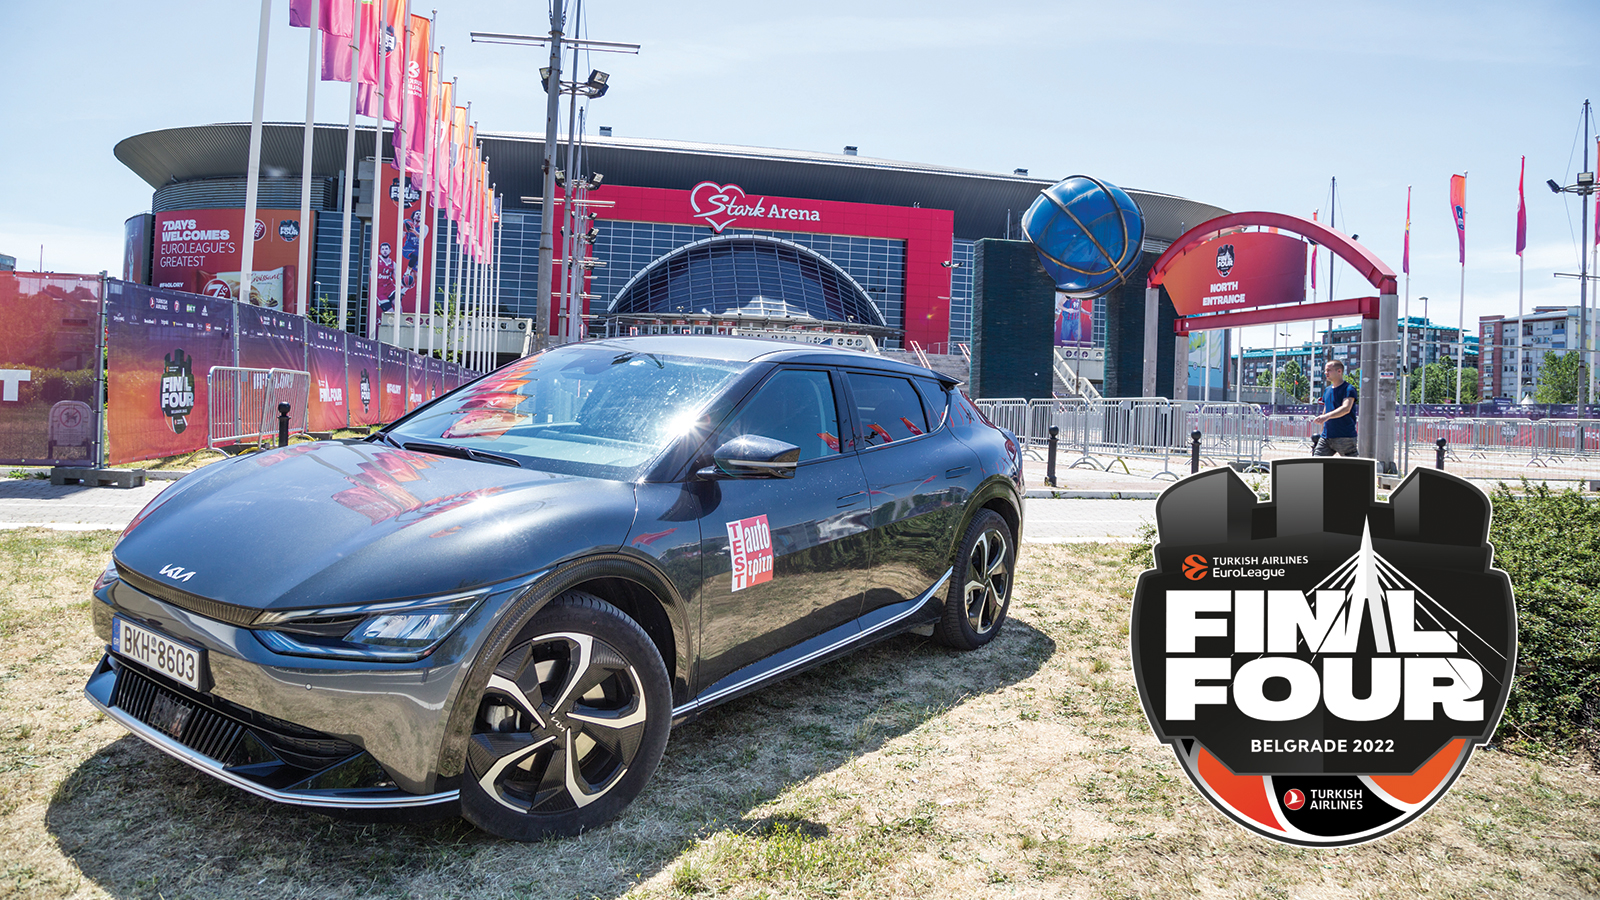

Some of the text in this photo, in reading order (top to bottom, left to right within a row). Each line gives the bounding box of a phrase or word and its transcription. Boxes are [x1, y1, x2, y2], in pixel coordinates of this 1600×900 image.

[694, 194, 820, 221] Stark Arena
[162, 219, 197, 231] 7DAYS
[162, 229, 230, 242] WELCOMES
[161, 242, 236, 255] EUROLEAGUE'S
[160, 256, 206, 268] GREATEST
[1210, 281, 1238, 293] NORTH
[1202, 293, 1246, 307] ENTRANCE
[161, 392, 194, 408] FOUR
[744, 519, 770, 554] auto
[728, 523, 745, 589] TEST
